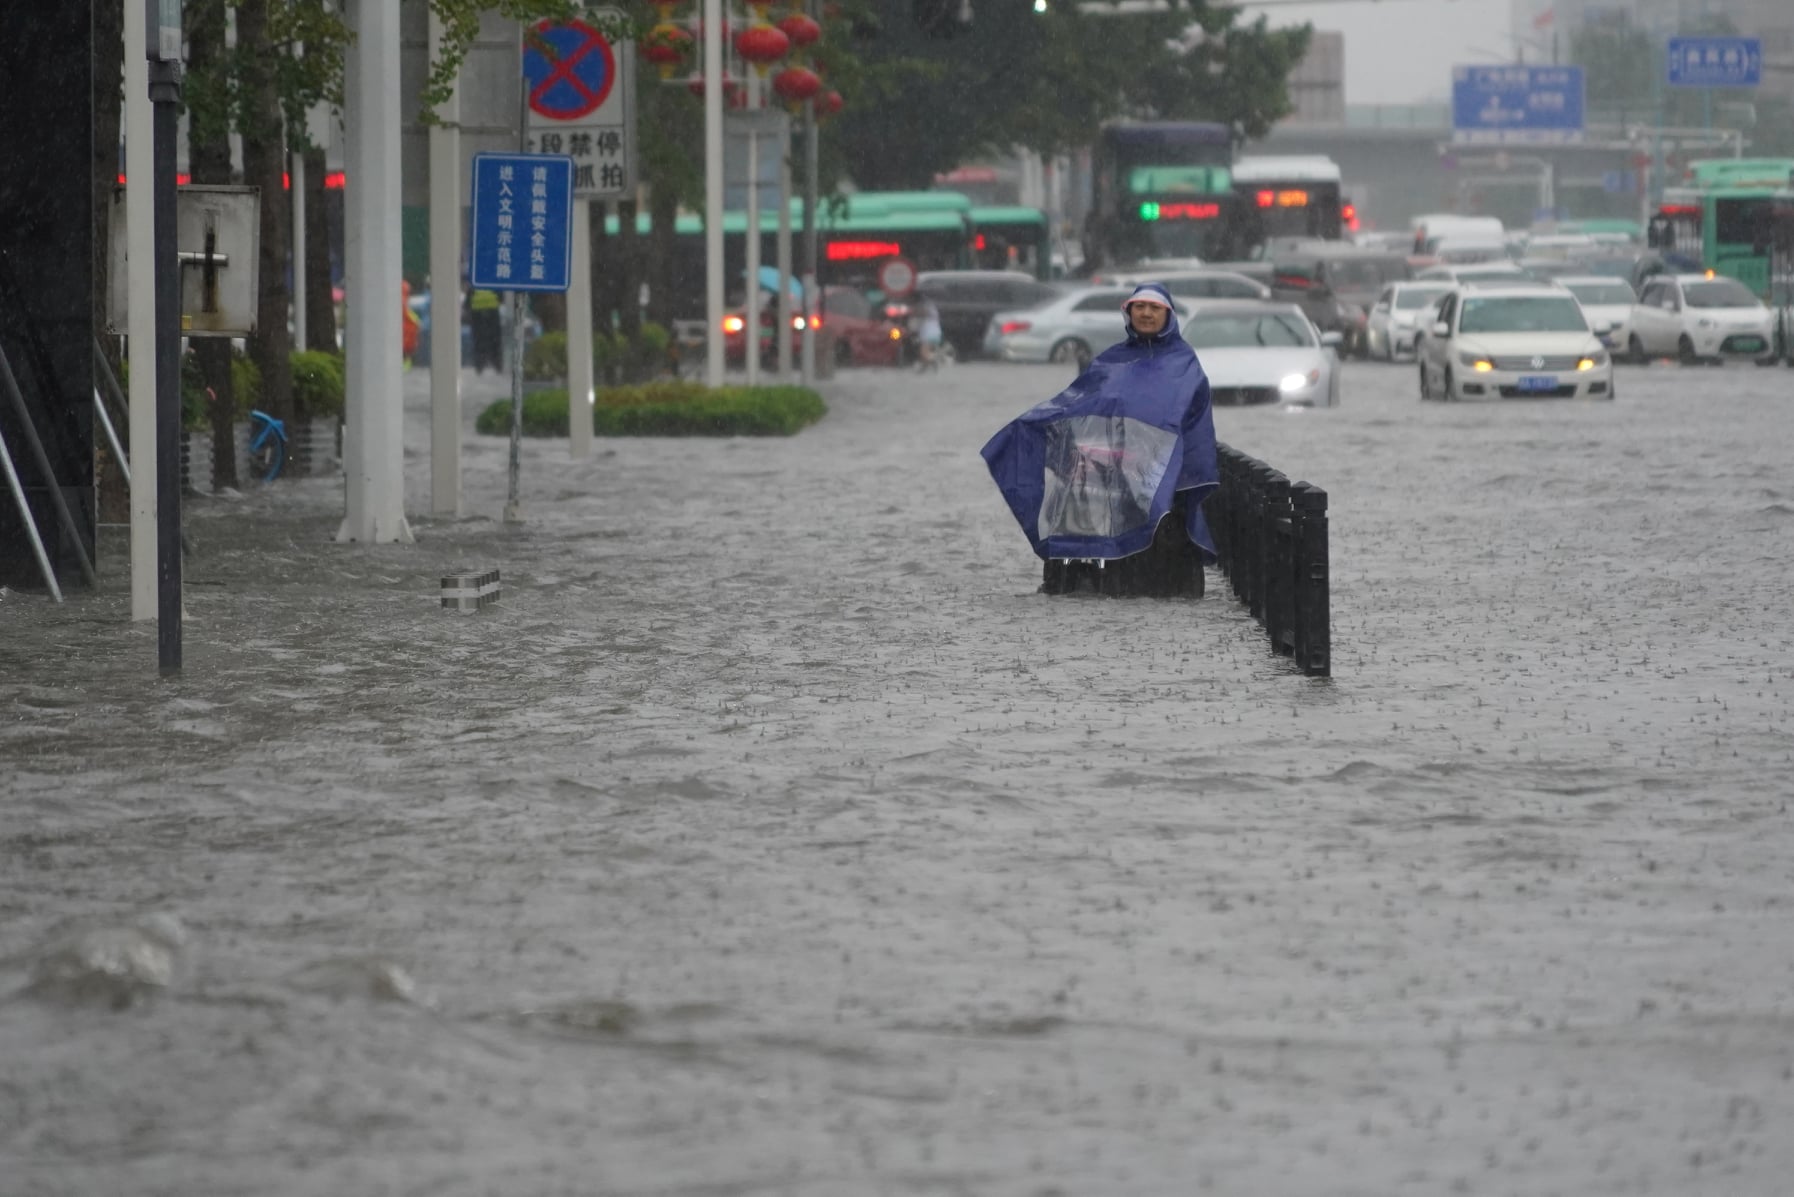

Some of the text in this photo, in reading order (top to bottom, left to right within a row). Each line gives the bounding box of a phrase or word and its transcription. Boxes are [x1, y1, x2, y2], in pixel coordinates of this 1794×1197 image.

[528, 132, 621, 156] 段禁停
[496, 165, 514, 279] 进入文明示范路
[530, 166, 547, 280] 请佩戴安全头盔
